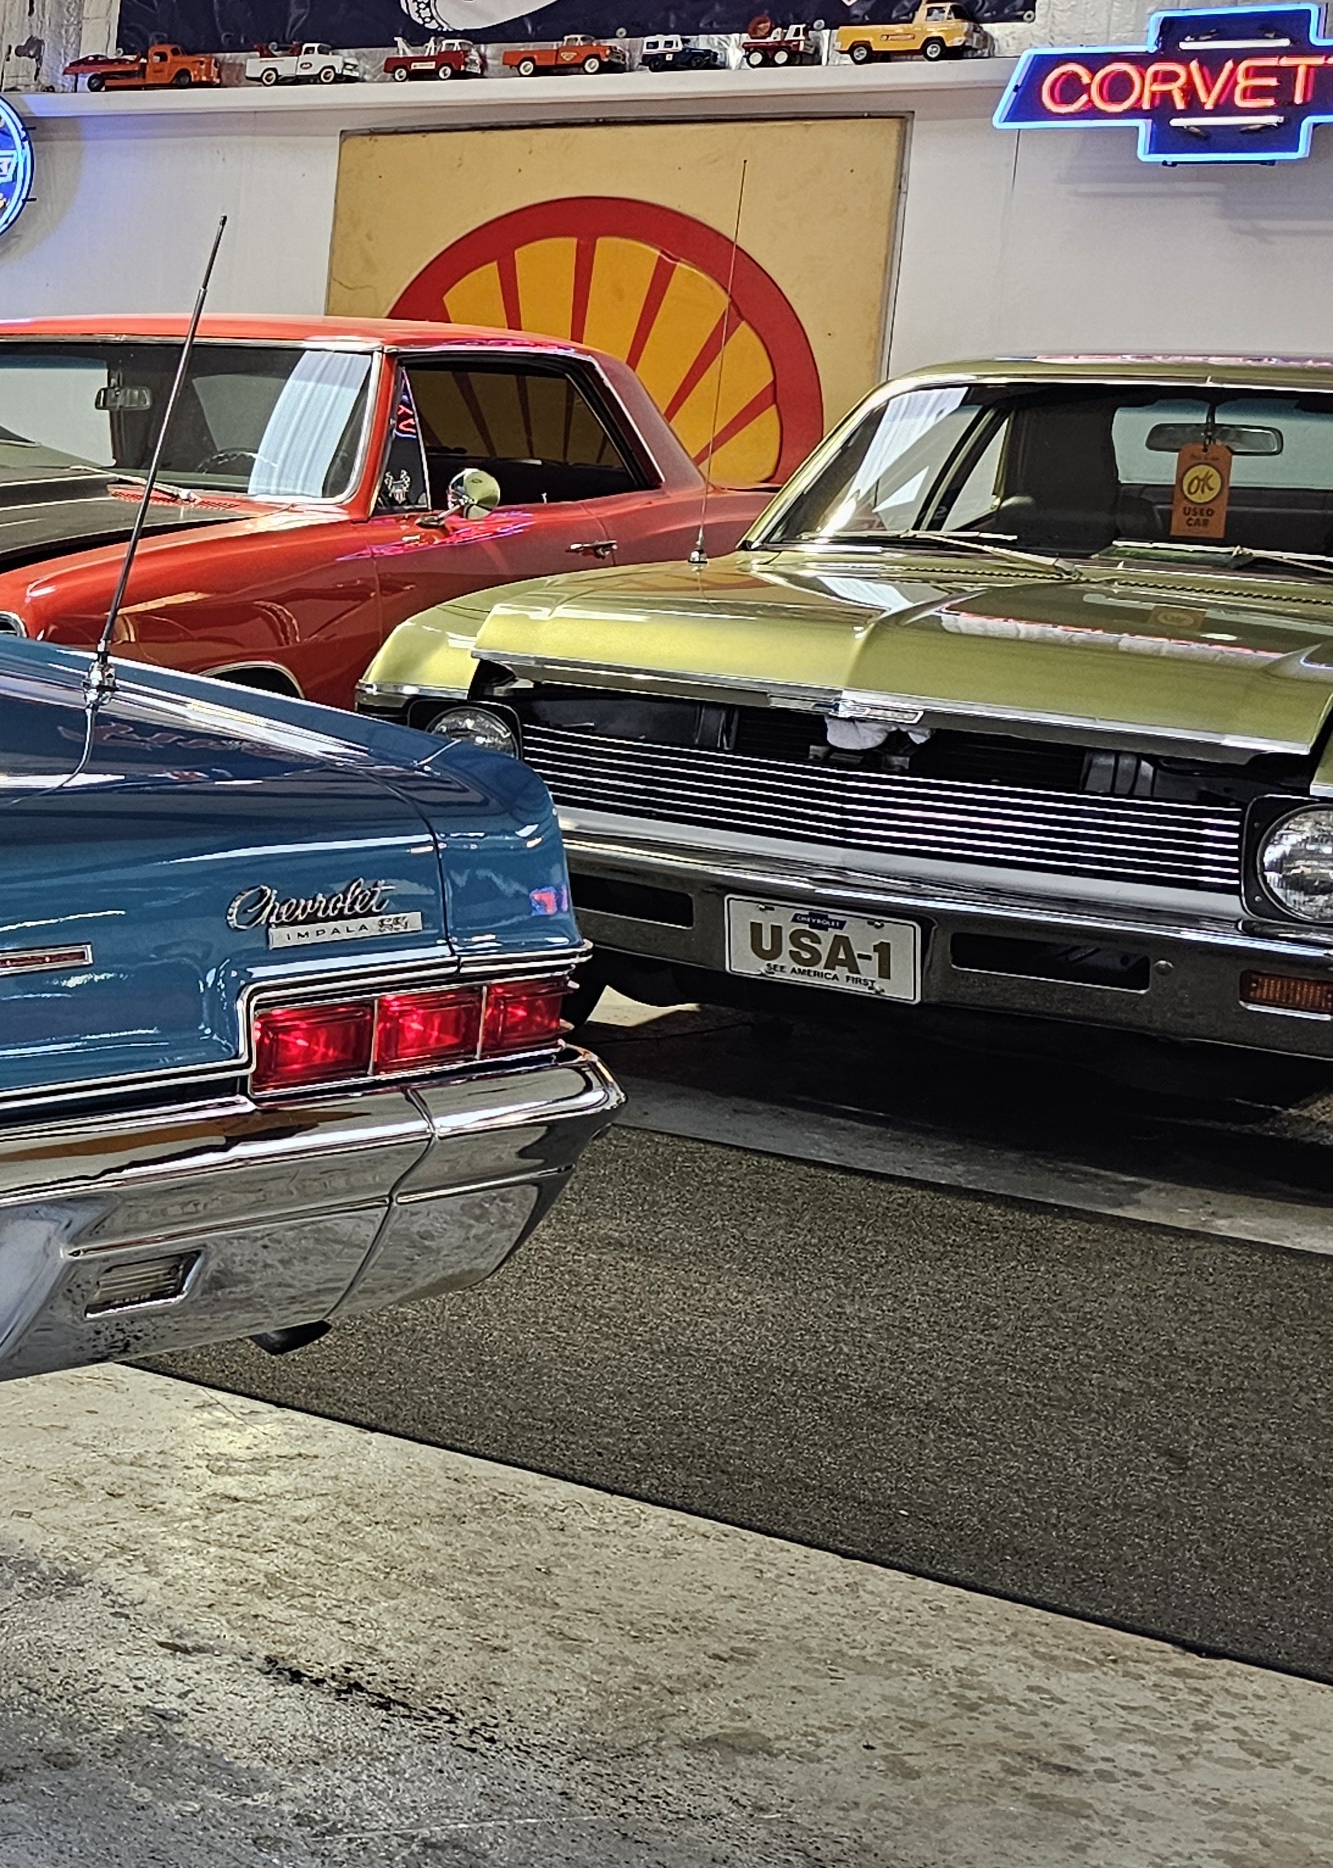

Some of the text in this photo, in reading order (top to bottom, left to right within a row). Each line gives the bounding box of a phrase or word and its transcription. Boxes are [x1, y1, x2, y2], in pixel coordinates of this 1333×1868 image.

[1041, 56, 1333, 114] CORVET
[1187, 470, 1215, 495] OK
[1183, 506, 1214, 517] USED
[1186, 517, 1210, 527] CAR
[226, 877, 397, 931] Chevrolet
[286, 915, 410, 942] IMPALA SS
[795, 914, 841, 928] CHEVROLET
[750, 921, 891, 980] USA-1
[765, 963, 877, 988] SEE AMERICA FIRST
